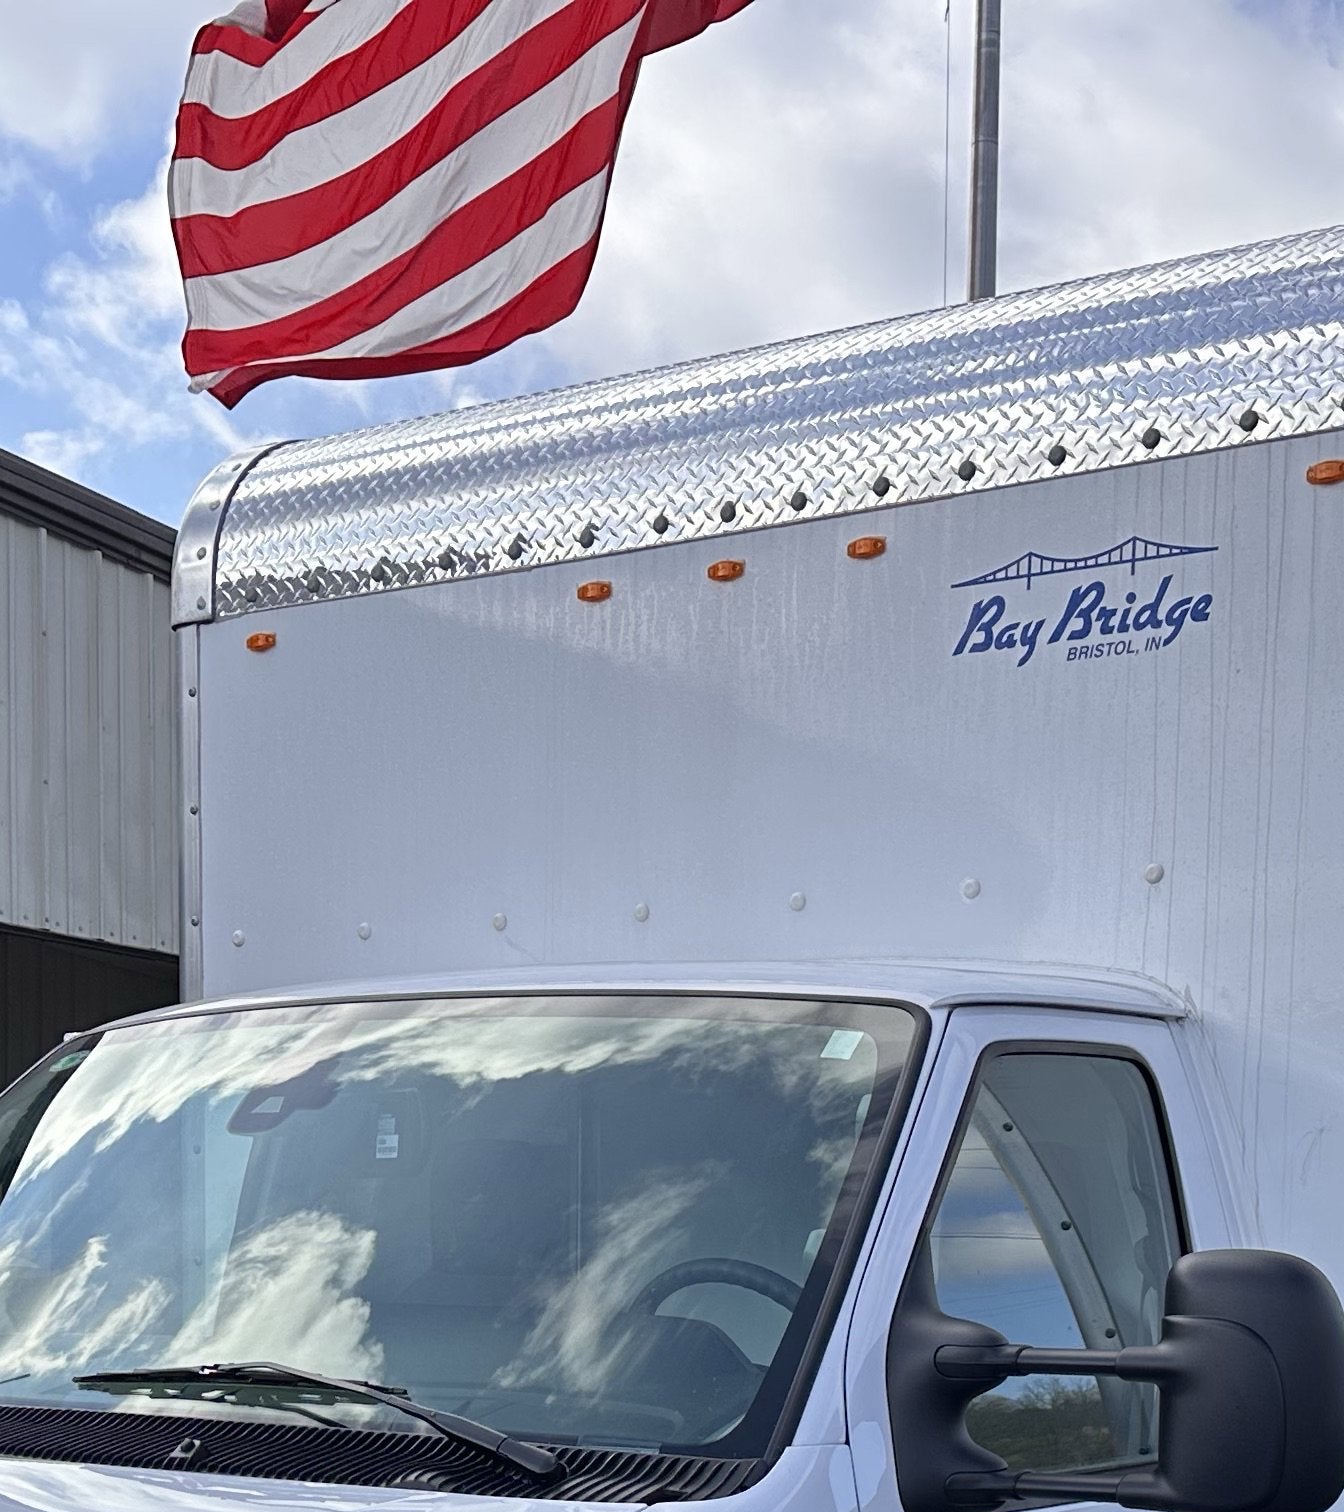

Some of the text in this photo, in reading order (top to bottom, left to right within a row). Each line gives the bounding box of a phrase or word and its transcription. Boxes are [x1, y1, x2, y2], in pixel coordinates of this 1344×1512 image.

[952, 573, 1213, 668] Bay Bridge
[1066, 636, 1162, 662] BRISTOL, IN
